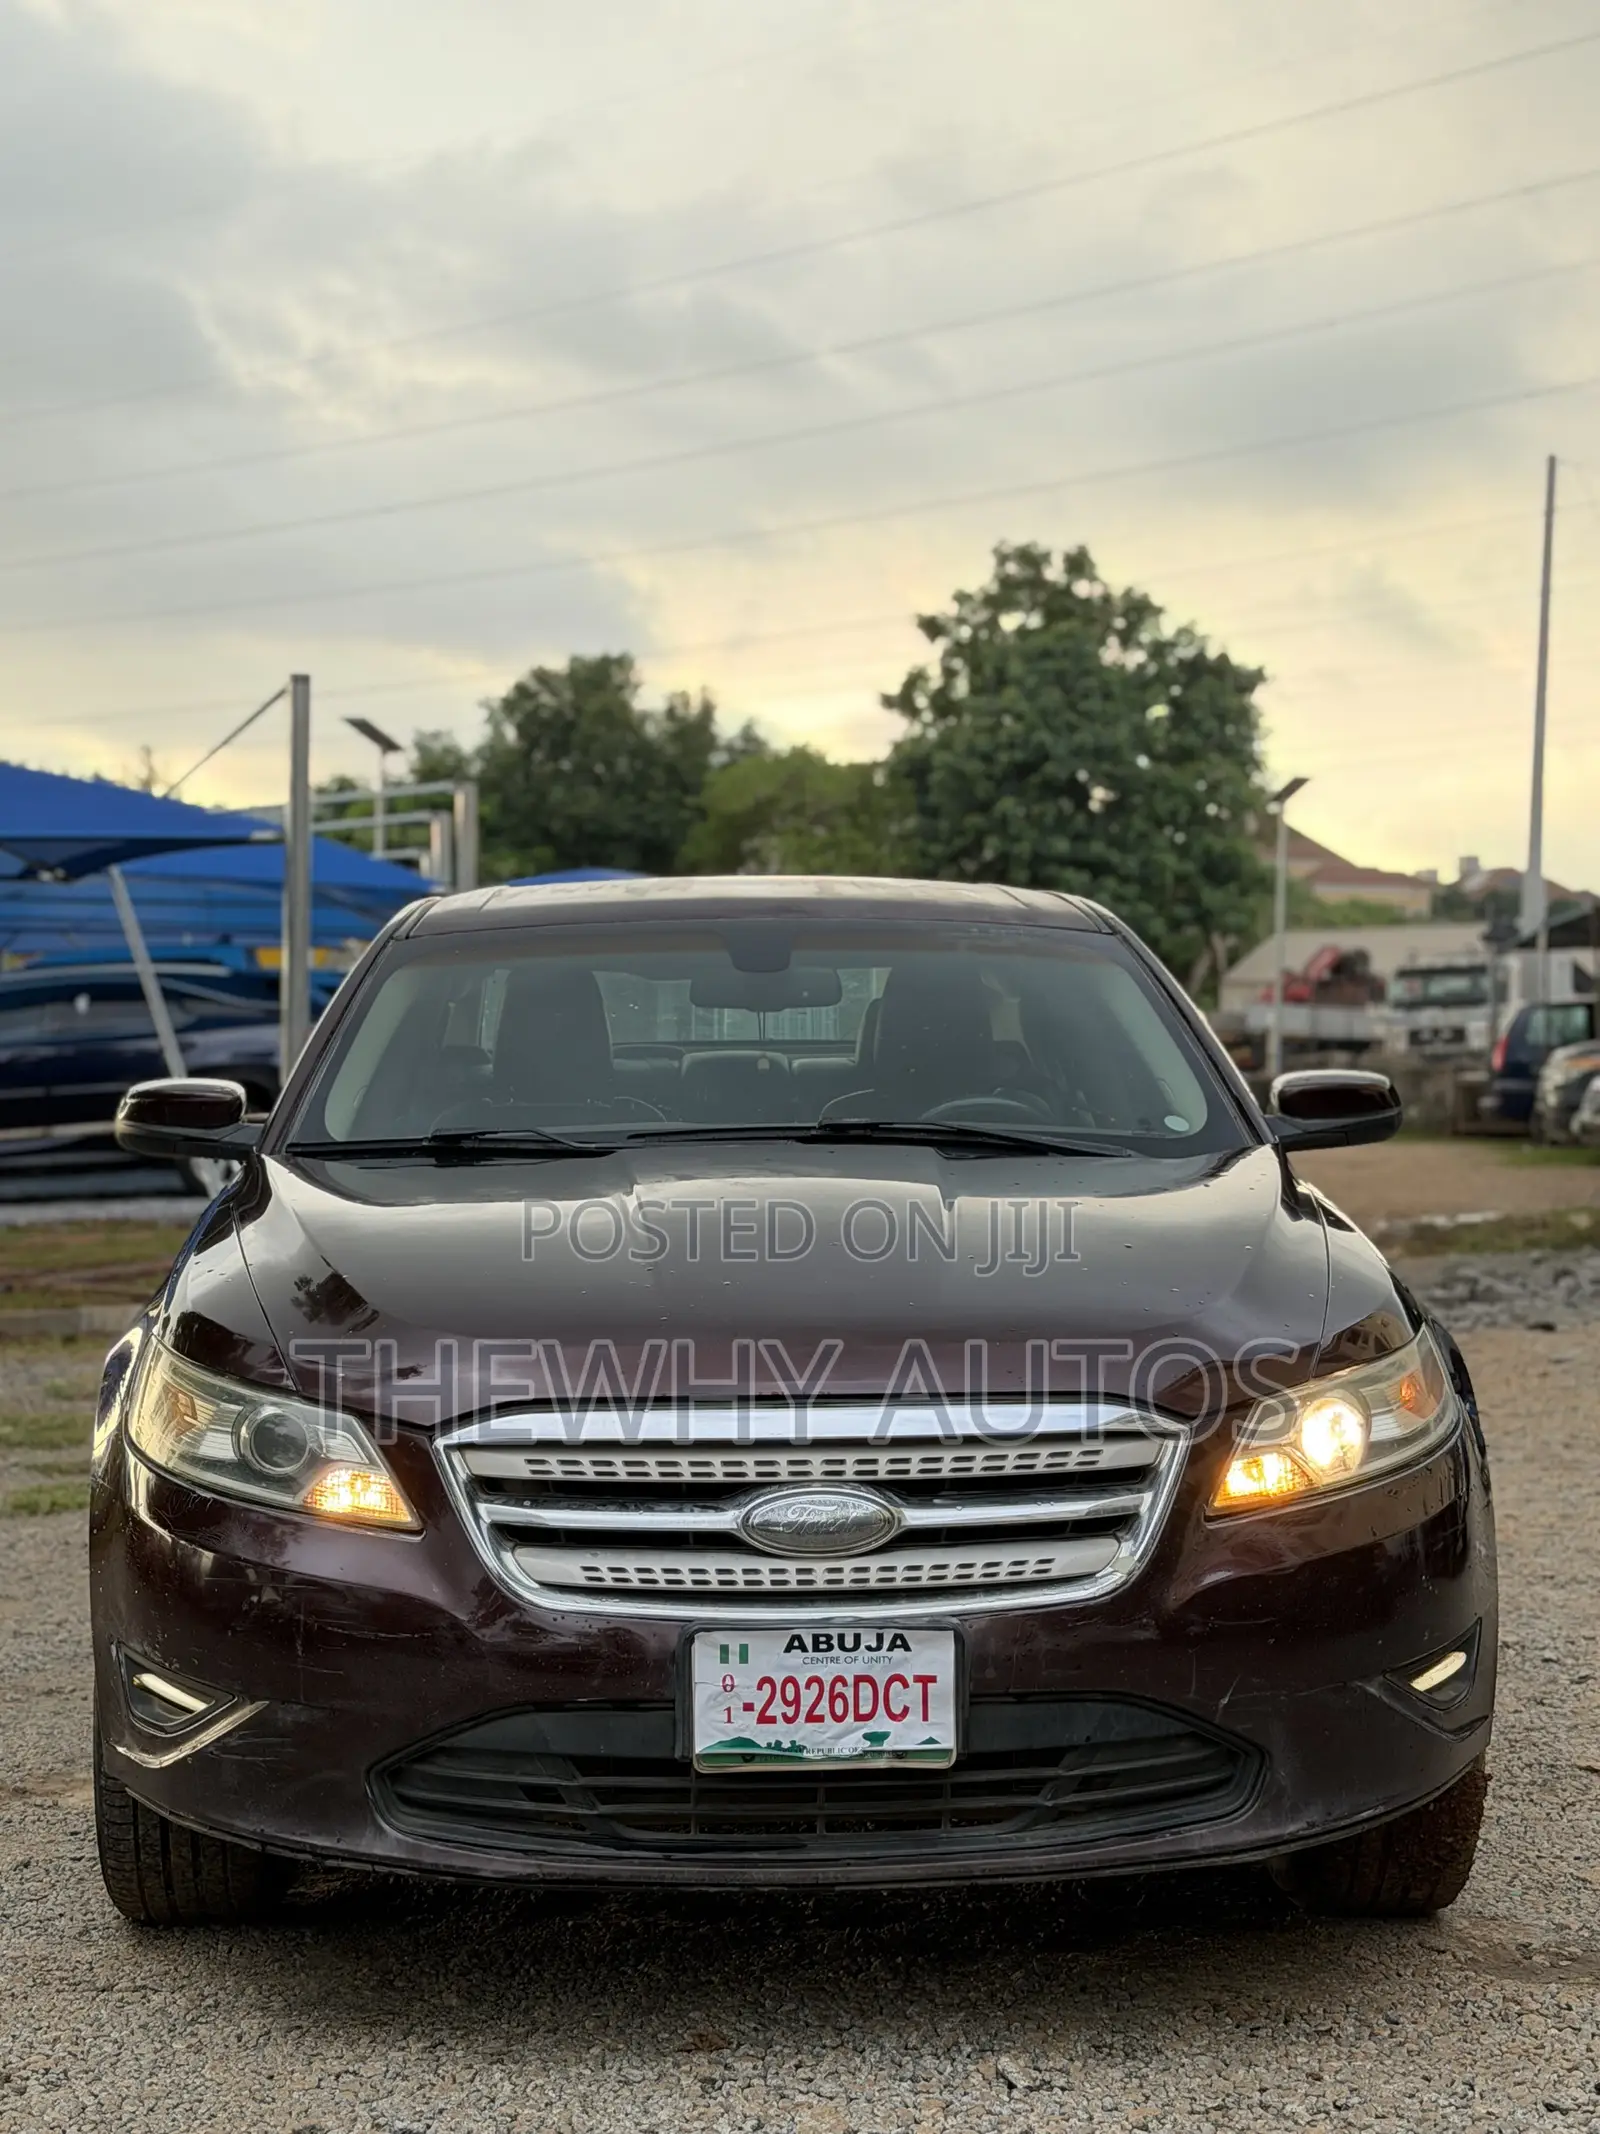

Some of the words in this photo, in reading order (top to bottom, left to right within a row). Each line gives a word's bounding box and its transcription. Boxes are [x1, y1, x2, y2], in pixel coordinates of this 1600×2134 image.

[783, 1633, 912, 1653] ABUJA
[802, 1656, 841, 1666] CENTRE
[844, 1655, 858, 1665] OF
[862, 1655, 893, 1665] UNITY
